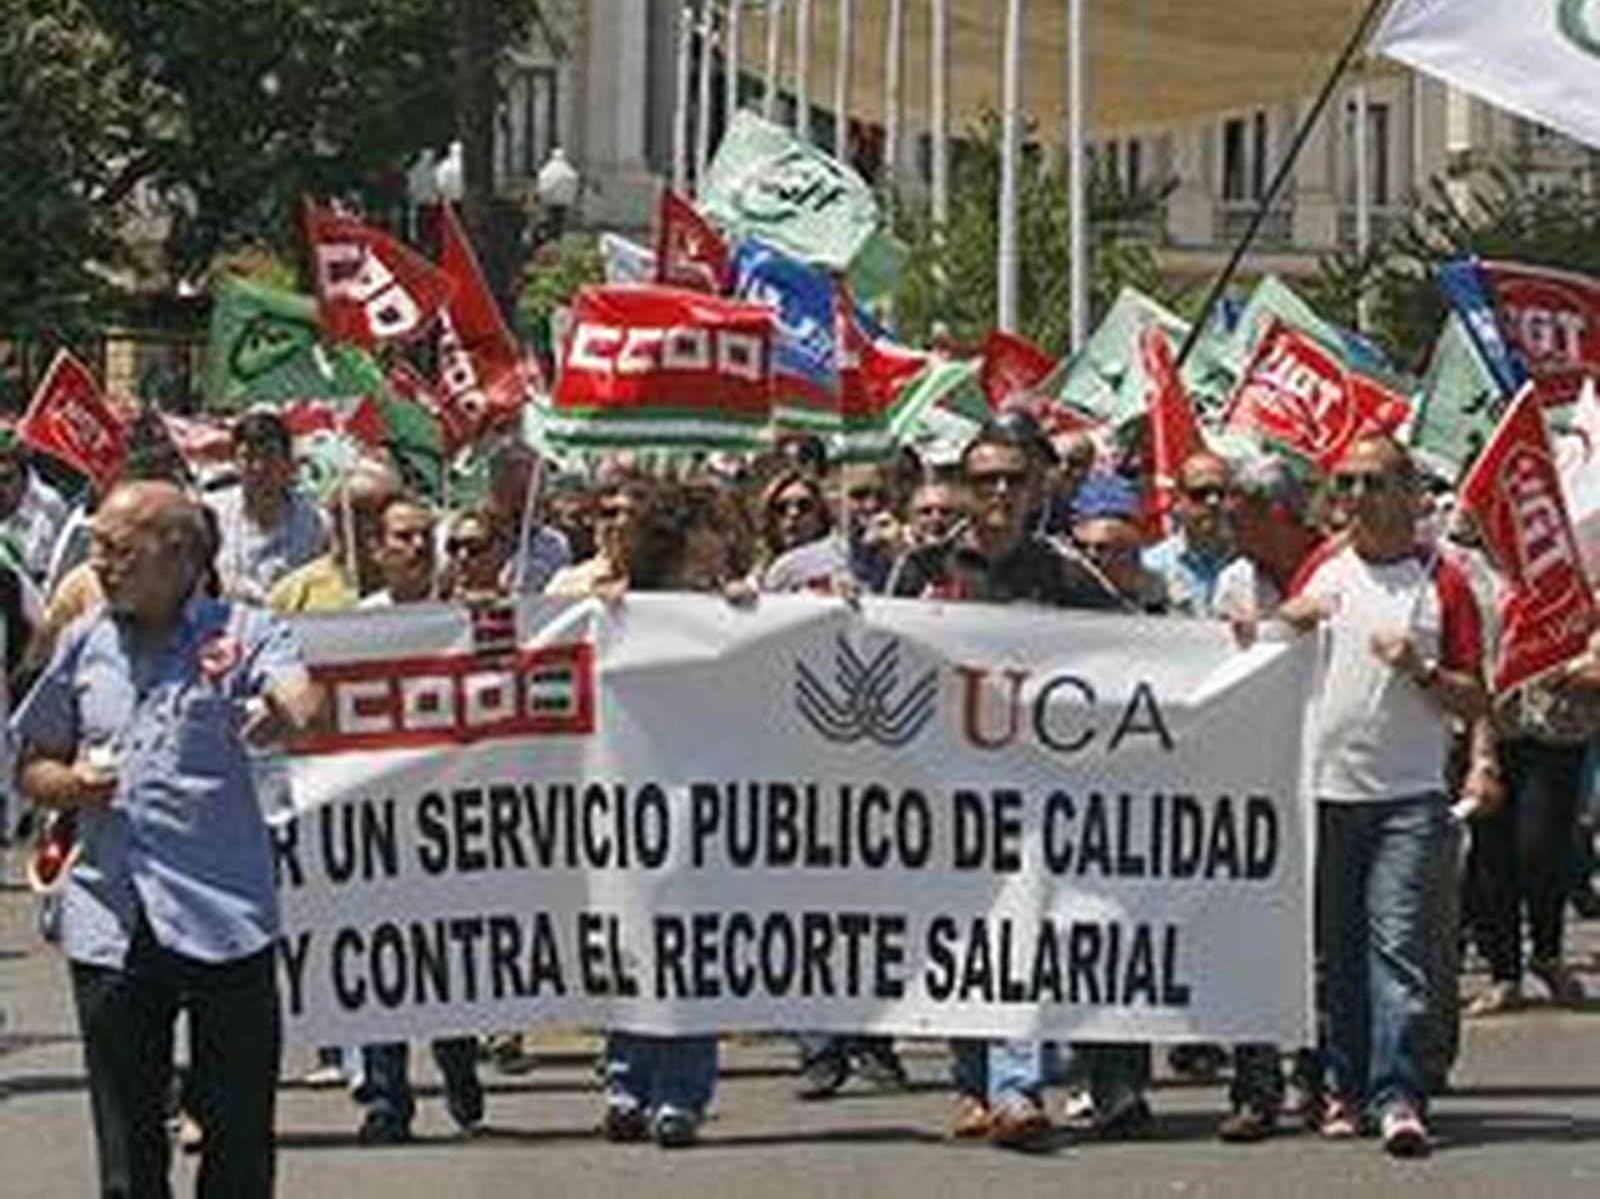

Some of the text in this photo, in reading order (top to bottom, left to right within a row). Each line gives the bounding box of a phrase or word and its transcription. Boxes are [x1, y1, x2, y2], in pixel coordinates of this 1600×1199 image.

[568, 324, 764, 381] CCOO
[955, 666, 1174, 752] UCA
[320, 797, 397, 884] UN
[418, 783, 670, 876] SERVICIO
[691, 781, 931, 869] PUBLICO
[953, 789, 1023, 874] DE
[1042, 790, 1279, 880] CALIDAD
[278, 911, 1192, 1016] Y CONTRA EL RECORTE SALARIAL
